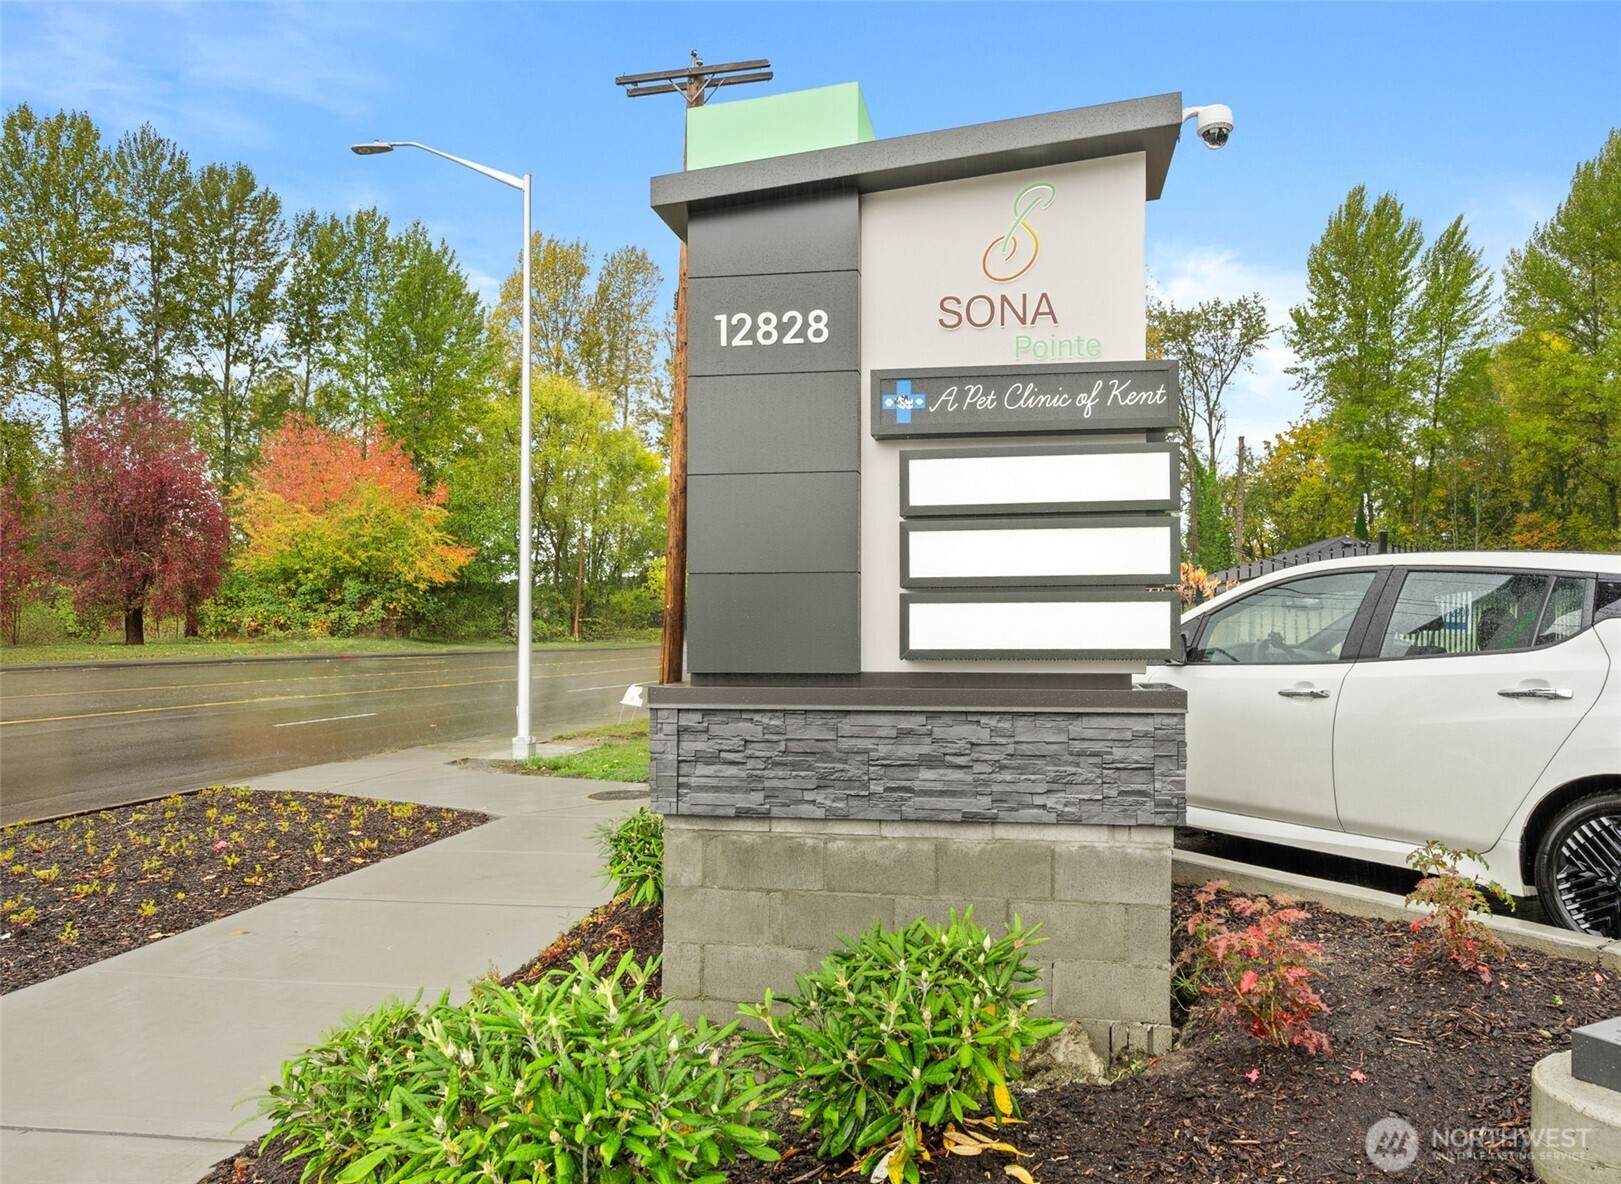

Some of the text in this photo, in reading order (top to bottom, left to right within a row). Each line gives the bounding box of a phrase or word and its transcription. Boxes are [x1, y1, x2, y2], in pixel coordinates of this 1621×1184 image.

[714, 309, 829, 347] 12828
[938, 292, 1059, 330] SONA
[1014, 334, 1102, 360] Pointe
[929, 379, 1168, 418] A Pet Clinic of Kent
